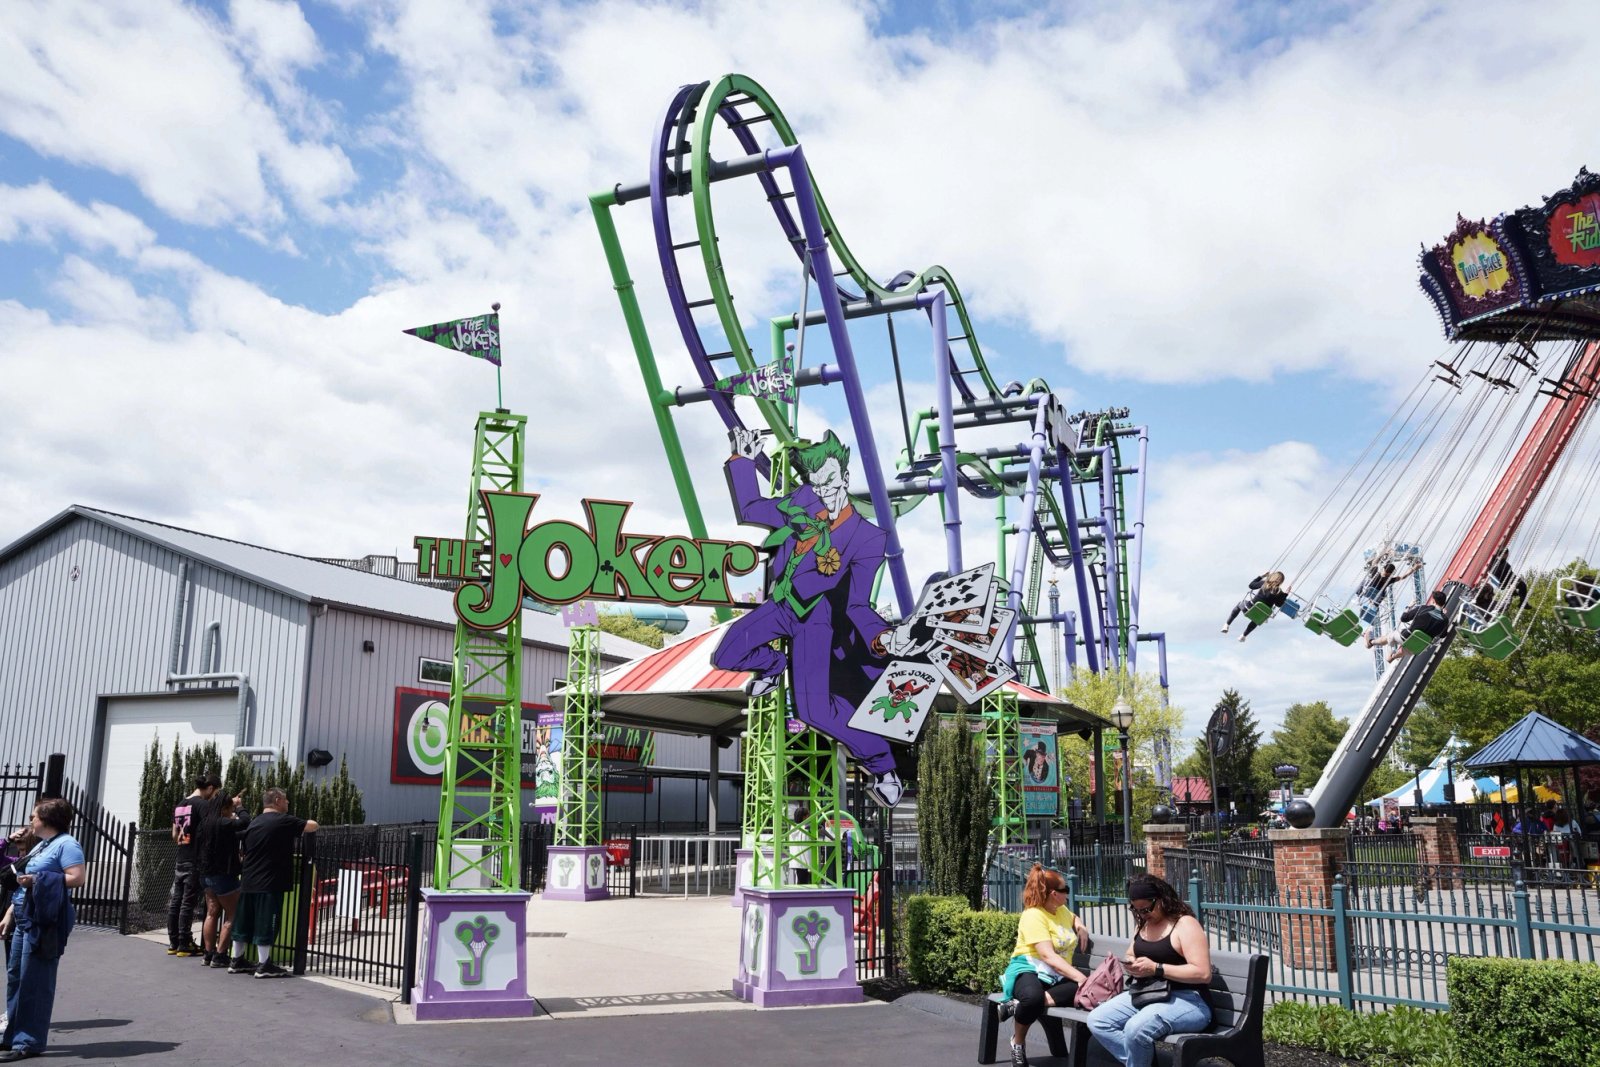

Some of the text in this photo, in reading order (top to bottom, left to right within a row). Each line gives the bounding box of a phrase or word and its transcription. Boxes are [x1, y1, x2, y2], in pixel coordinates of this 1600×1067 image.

[1566, 211, 1597, 233] The
[1565, 223, 1600, 253] Rid
[452, 323, 498, 350] JOKER
[461, 319, 484, 332] THE
[757, 363, 779, 378] THE
[748, 371, 793, 396] JOKER
[414, 536, 485, 579] THE
[888, 670, 936, 685] THE JOKER
